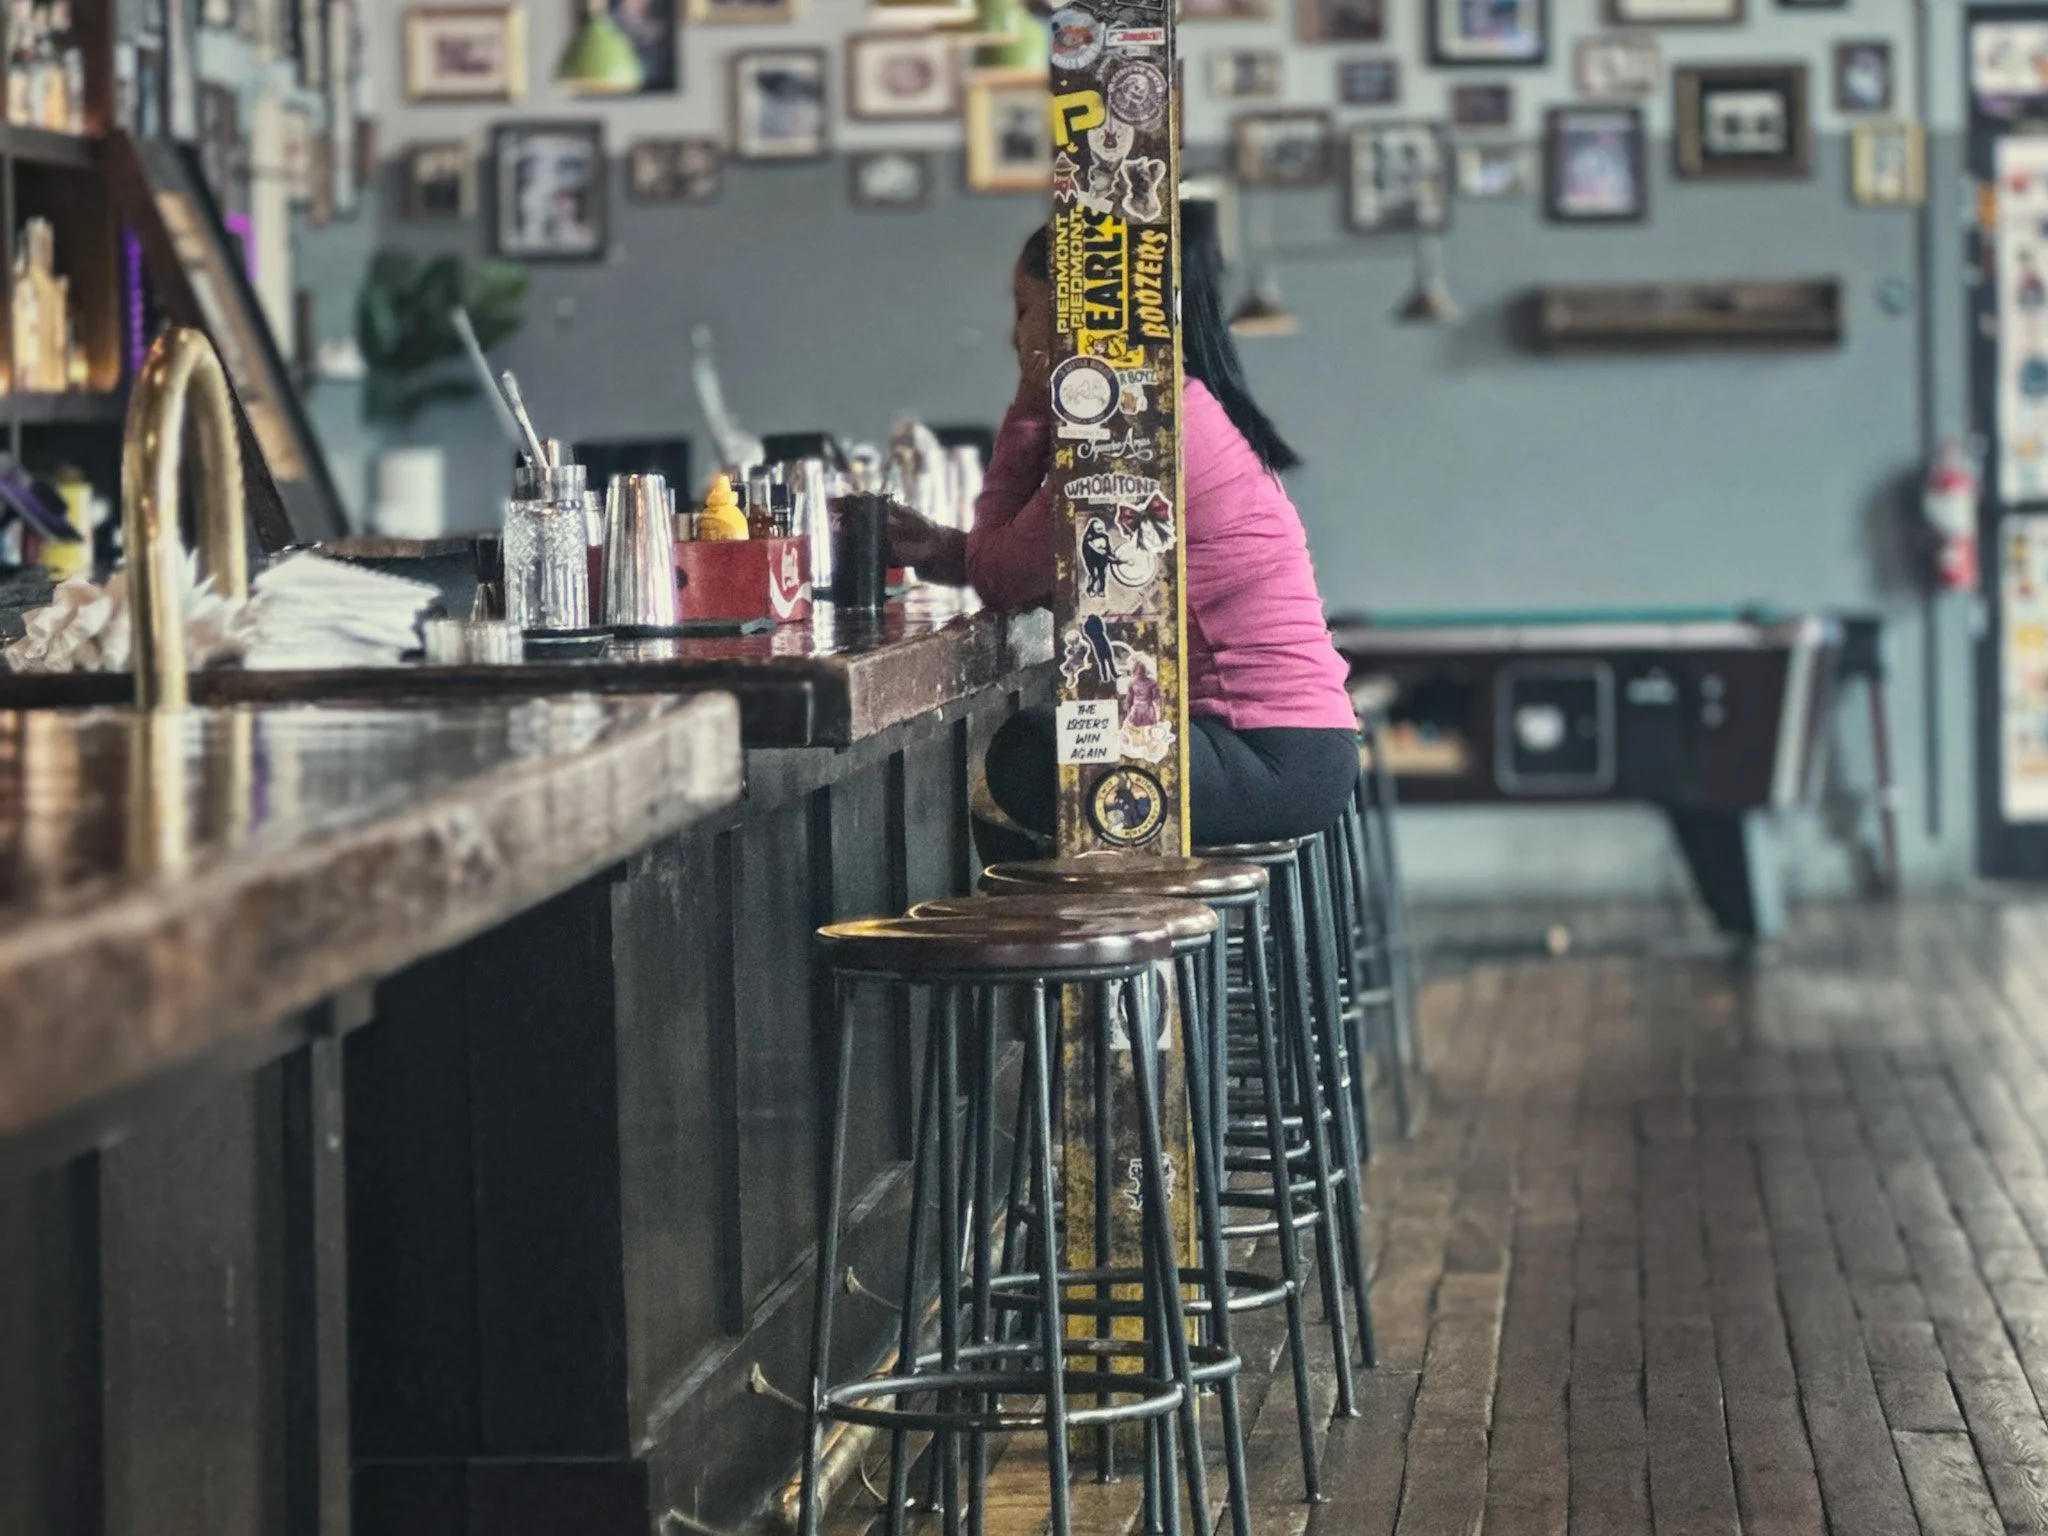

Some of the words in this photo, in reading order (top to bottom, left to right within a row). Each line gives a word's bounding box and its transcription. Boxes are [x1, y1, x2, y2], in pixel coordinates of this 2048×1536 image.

[1056, 213, 1070, 334] PIEDMONT
[1070, 208, 1083, 328] PIEDMONT
[1133, 229, 1172, 338] BOOZERS
[1078, 704, 1096, 715] THE
[1066, 718, 1109, 730] LOSERS
[1075, 733, 1100, 744] WIN
[1070, 747, 1107, 759] AGAIN
